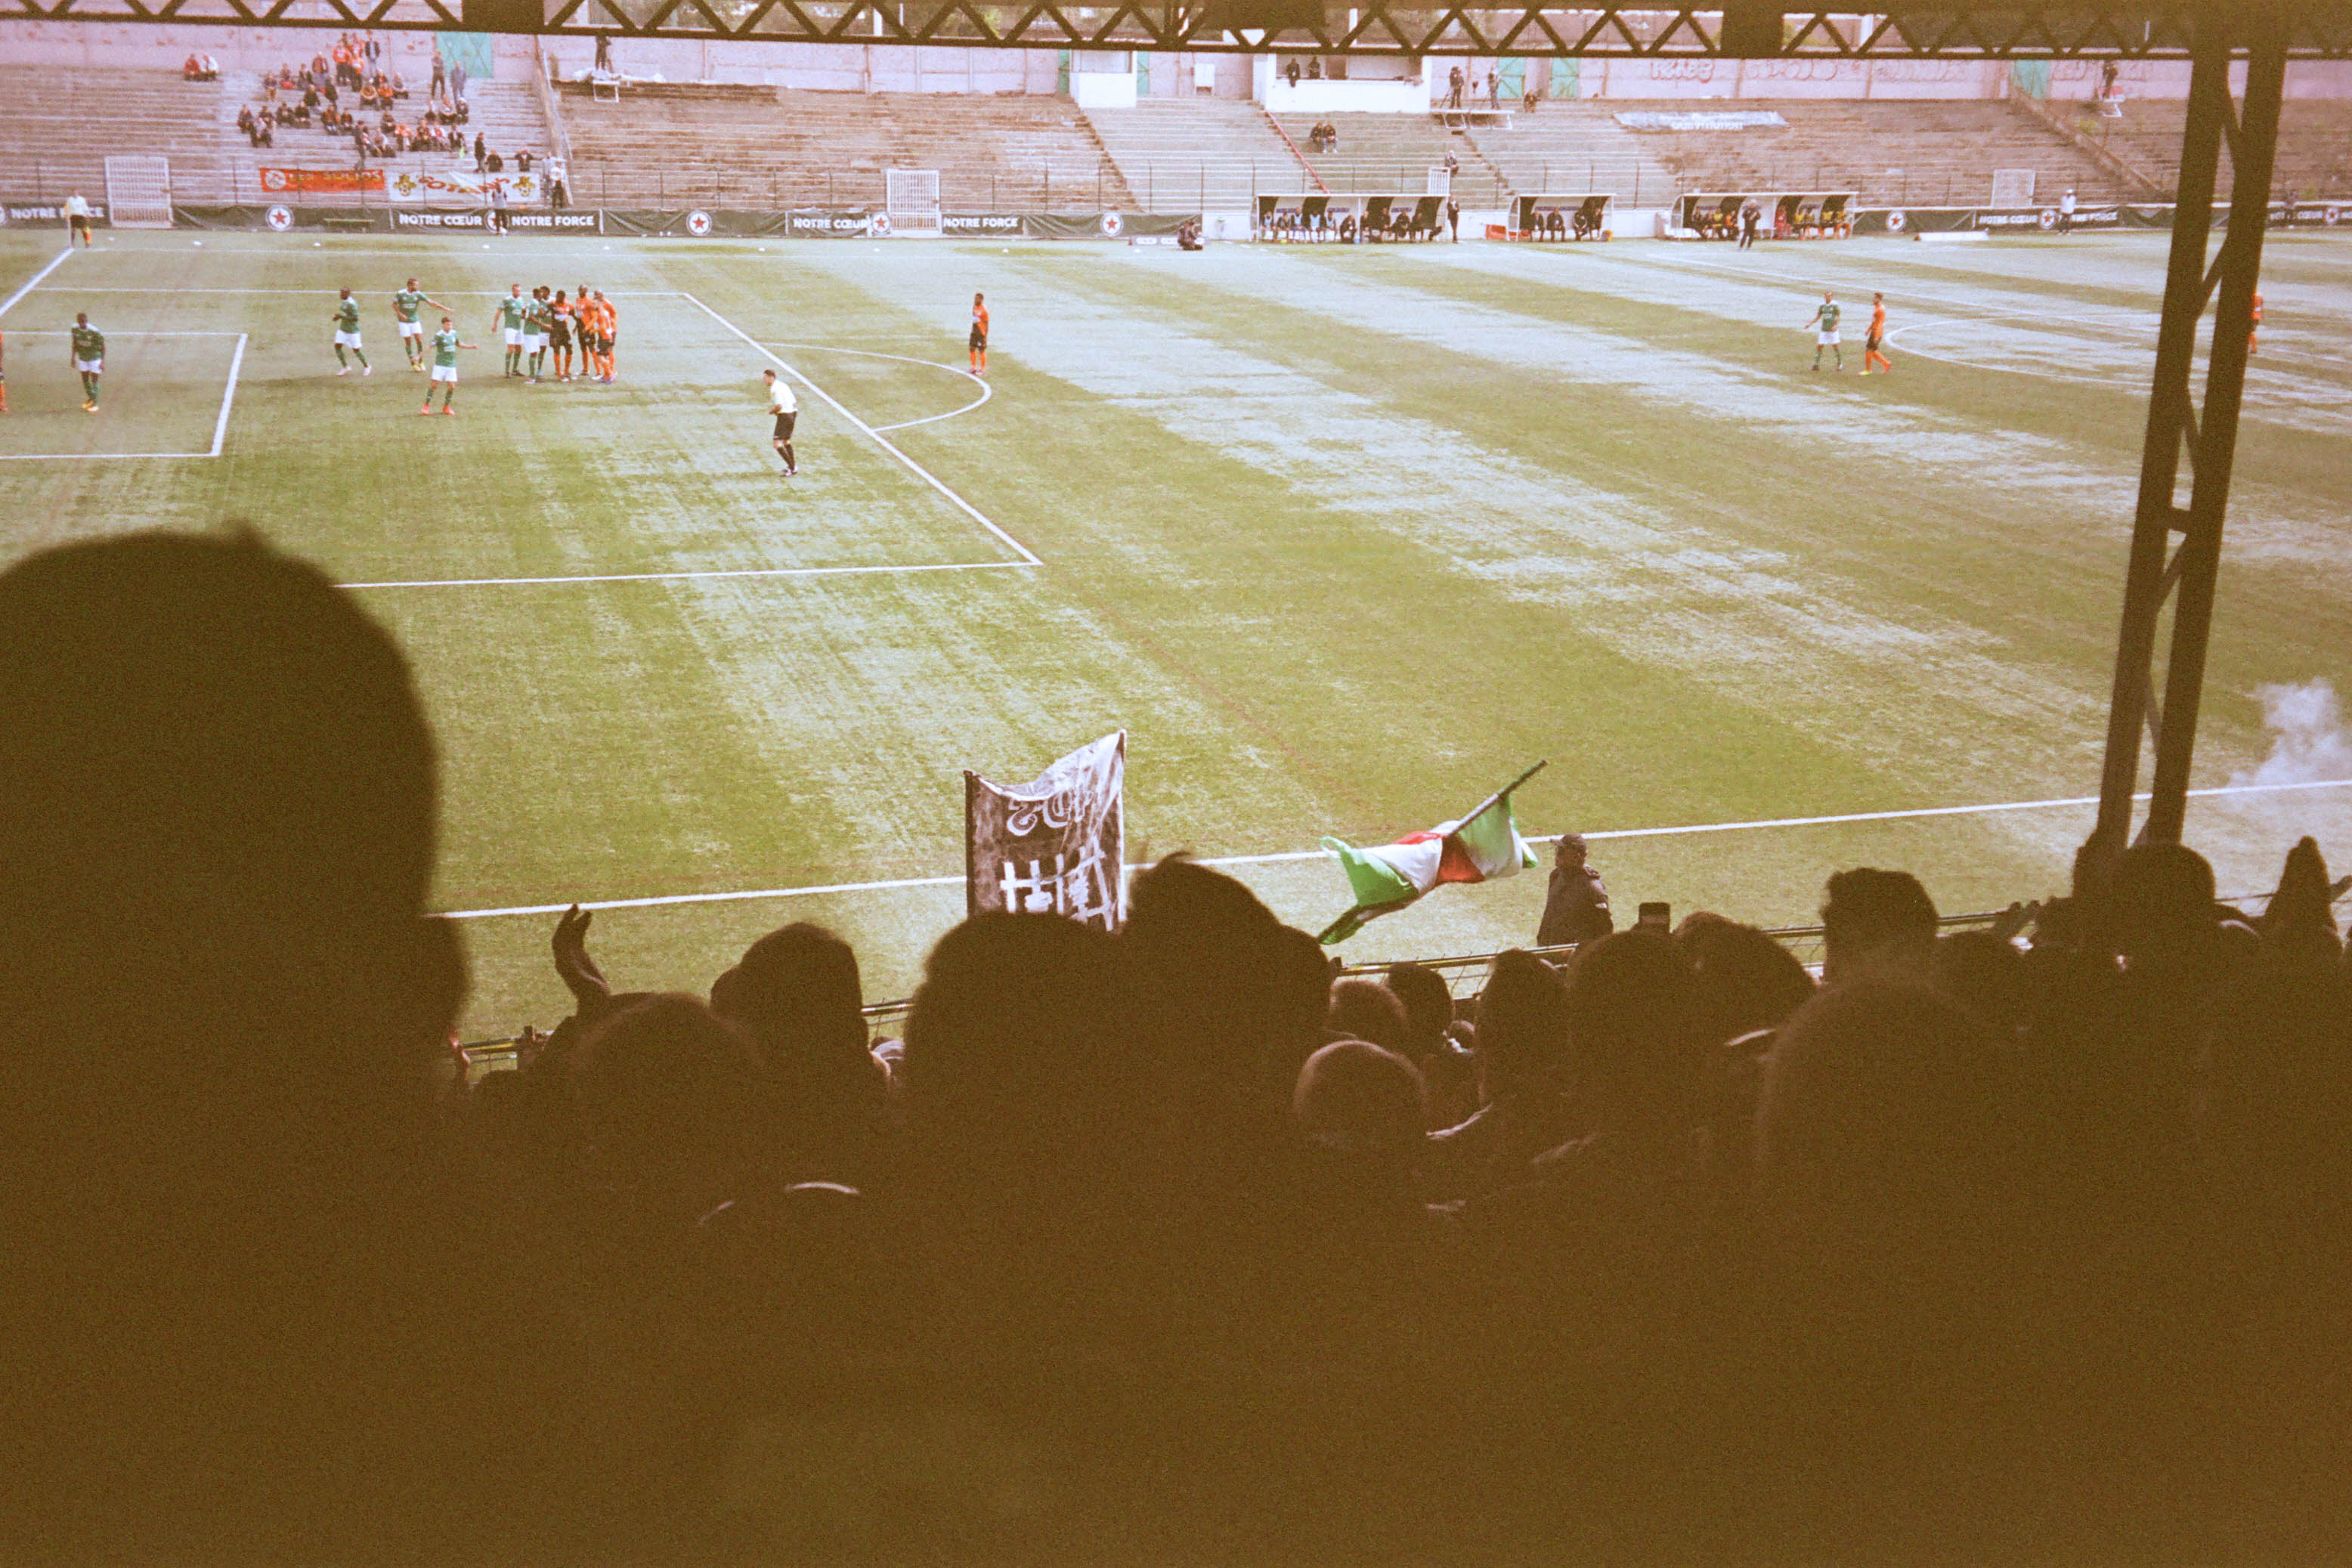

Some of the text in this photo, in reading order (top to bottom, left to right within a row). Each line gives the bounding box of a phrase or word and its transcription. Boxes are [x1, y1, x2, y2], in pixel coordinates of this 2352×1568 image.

[11, 207, 57, 218] NOTRE
[400, 213, 594, 227] NOTRE CŒUR NOTRE FORCE
[794, 218, 868, 229] NOTRE CŒUR
[944, 216, 1019, 227] NOTRE FORCE
[1979, 215, 2008, 224] NOTRE
